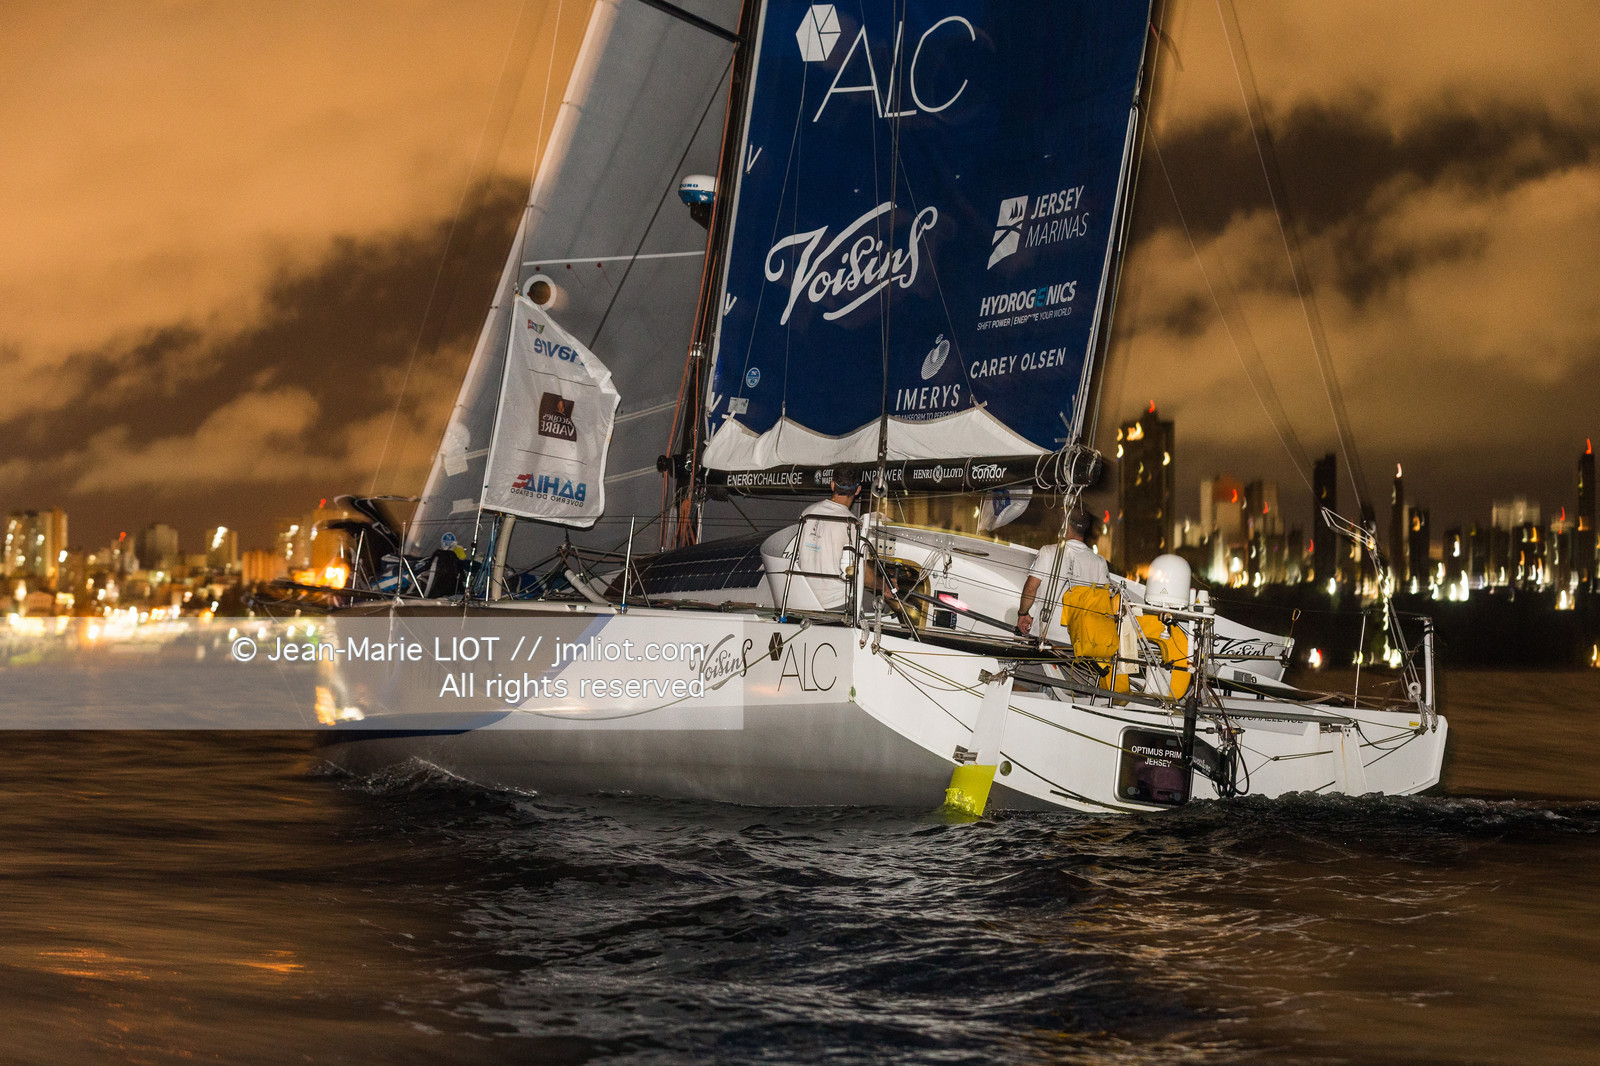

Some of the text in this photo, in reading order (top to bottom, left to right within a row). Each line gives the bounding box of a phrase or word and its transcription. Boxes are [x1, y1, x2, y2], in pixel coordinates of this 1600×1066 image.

[812, 15, 977, 123] ALC
[1030, 184, 1085, 220] JERSEY
[1024, 212, 1090, 248] MARINAS
[764, 201, 938, 326] Voisins
[979, 280, 1077, 317] HYDROGENICS
[970, 347, 1067, 379] CAREY OLSEN
[895, 383, 961, 411] IMERYS
[726, 472, 803, 486] ENERGYCHALLENGE
[913, 467, 964, 479] HENRI LLOYD
[971, 464, 1008, 480] condor
[777, 642, 838, 692] ALC
[1131, 745, 1183, 759] OPTIMUS PRIM
[1144, 757, 1172, 768] JERSEY
